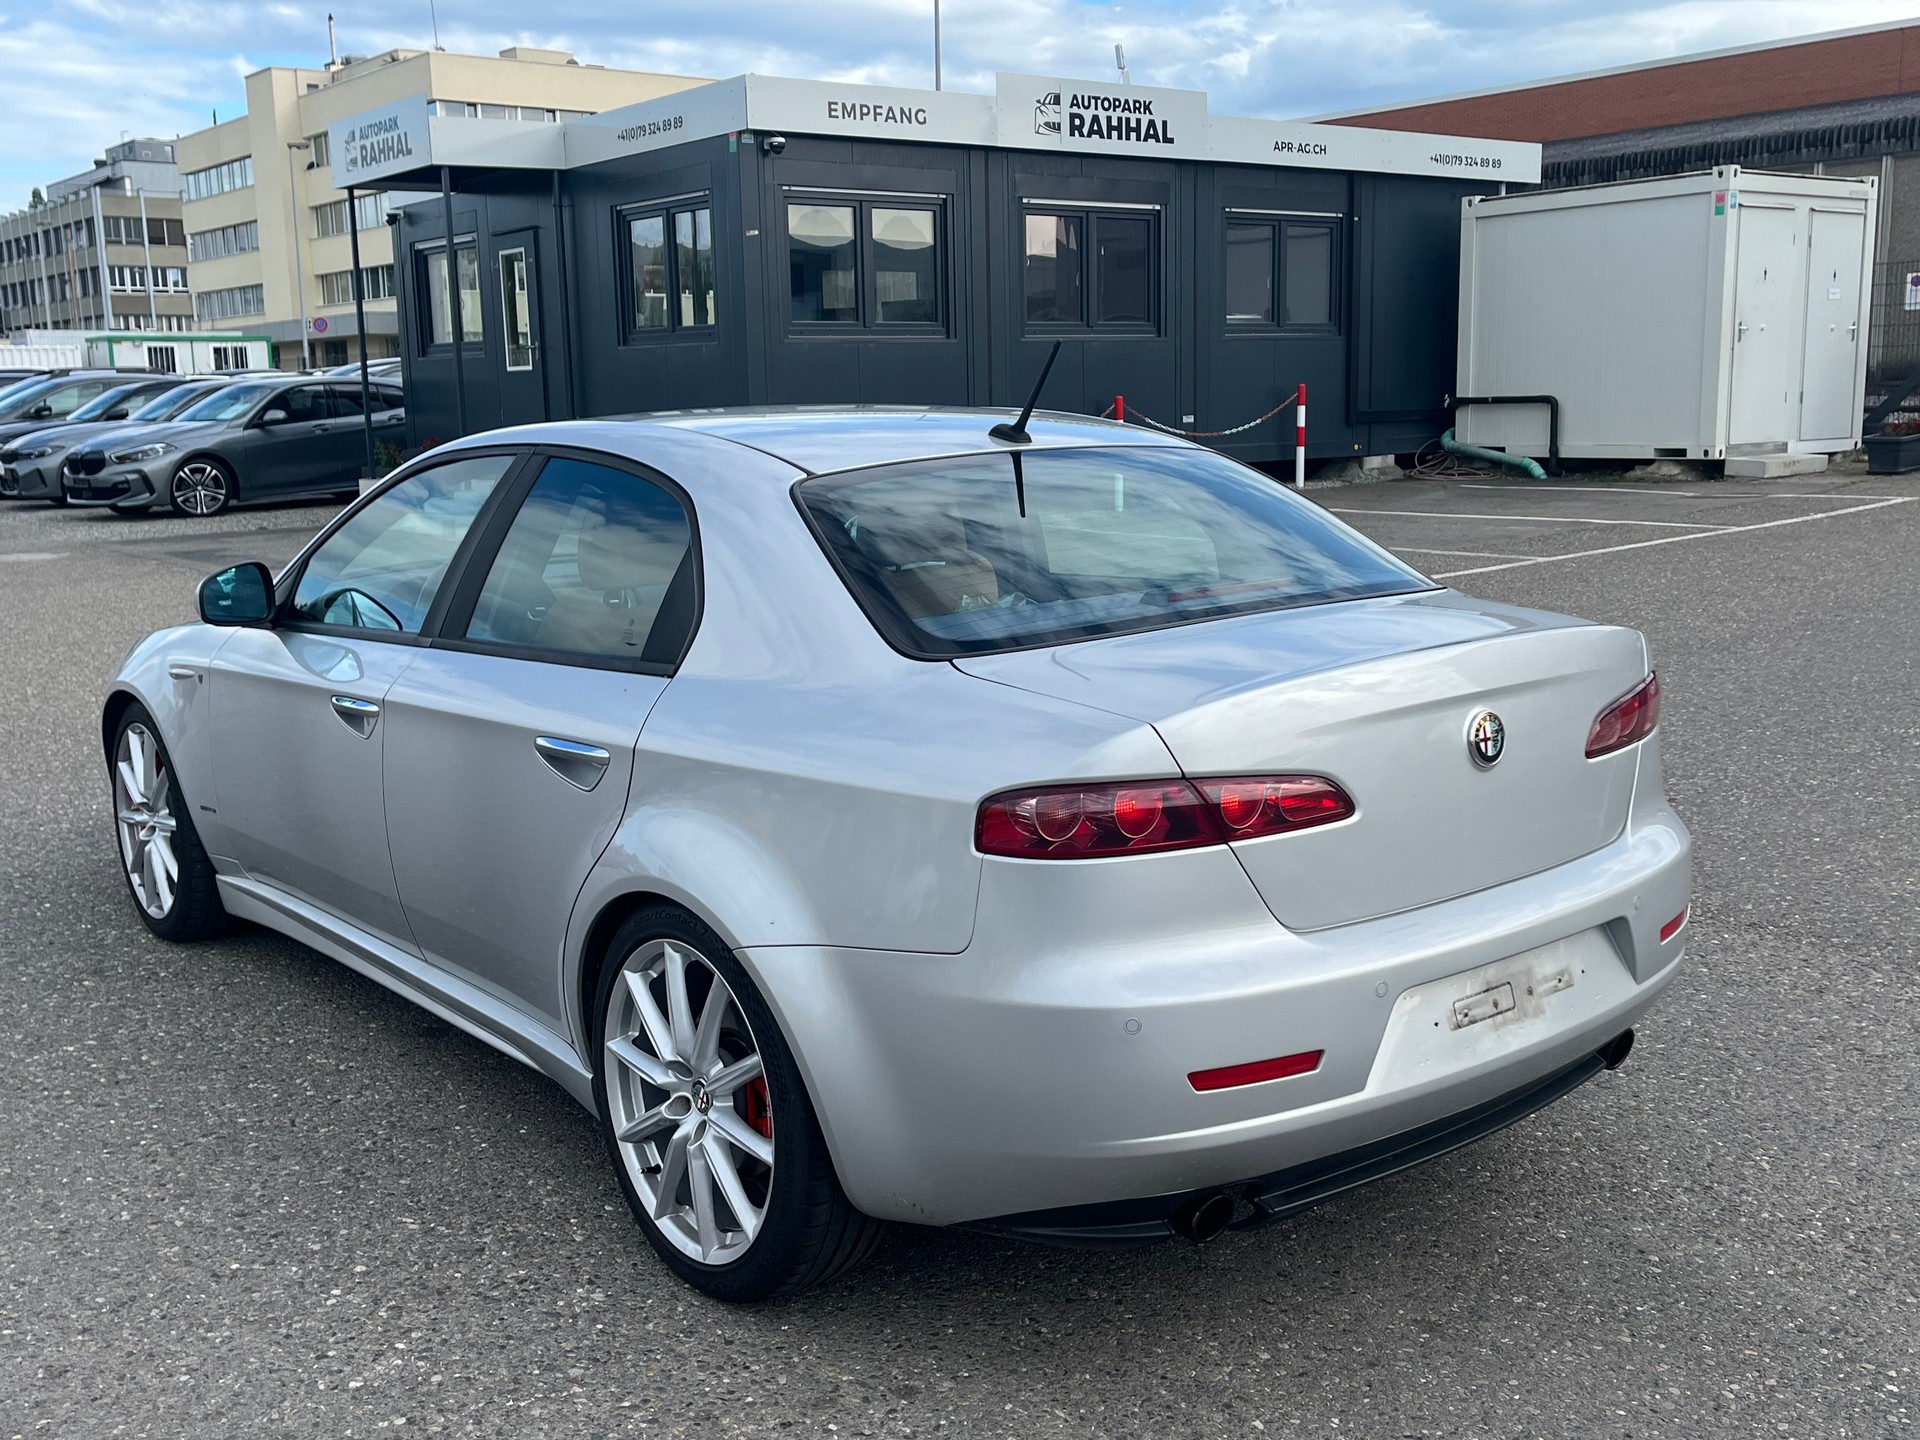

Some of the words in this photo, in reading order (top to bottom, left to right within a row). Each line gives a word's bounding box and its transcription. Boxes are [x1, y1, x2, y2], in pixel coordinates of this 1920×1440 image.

[827, 100, 927, 125] EMPFANG
[1069, 93, 1153, 115] AUTOPARK
[359, 114, 400, 141] AUTOPARK
[617, 124, 647, 142] +41(0)79
[647, 120, 661, 136] 324
[662, 118, 672, 132] 89
[673, 115, 683, 130] 89
[1069, 112, 1175, 144] RAHHAL
[360, 131, 413, 168] RAHHAL
[1273, 140, 1327, 155] APR-AG.CH
[1429, 153, 1463, 167] +41(0)79
[1464, 155, 1479, 167] 324
[1480, 157, 1490, 168] 89
[1491, 158, 1502, 169] 89
